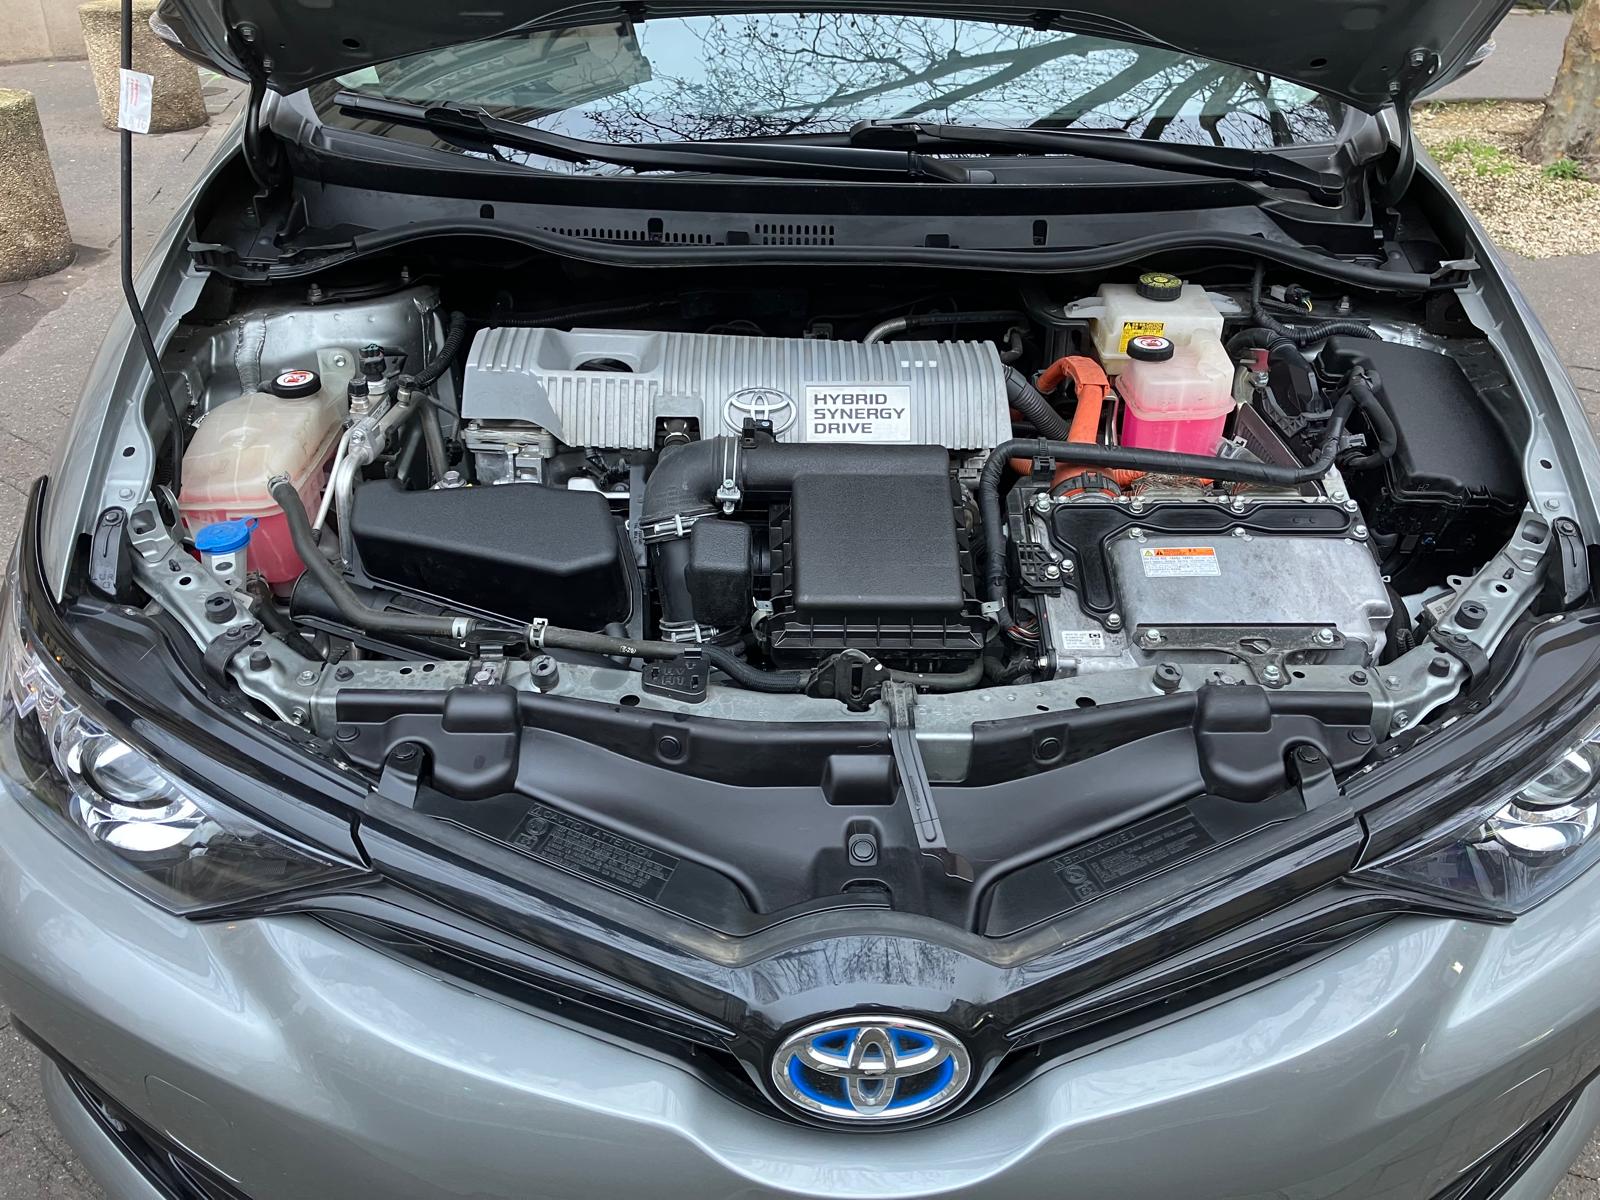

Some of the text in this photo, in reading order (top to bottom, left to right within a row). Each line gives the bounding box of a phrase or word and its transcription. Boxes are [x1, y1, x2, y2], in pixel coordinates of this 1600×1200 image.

[814, 394, 887, 405] HYBRID
[814, 408, 905, 419] SYNERGY
[814, 423, 873, 434] DRIVE
